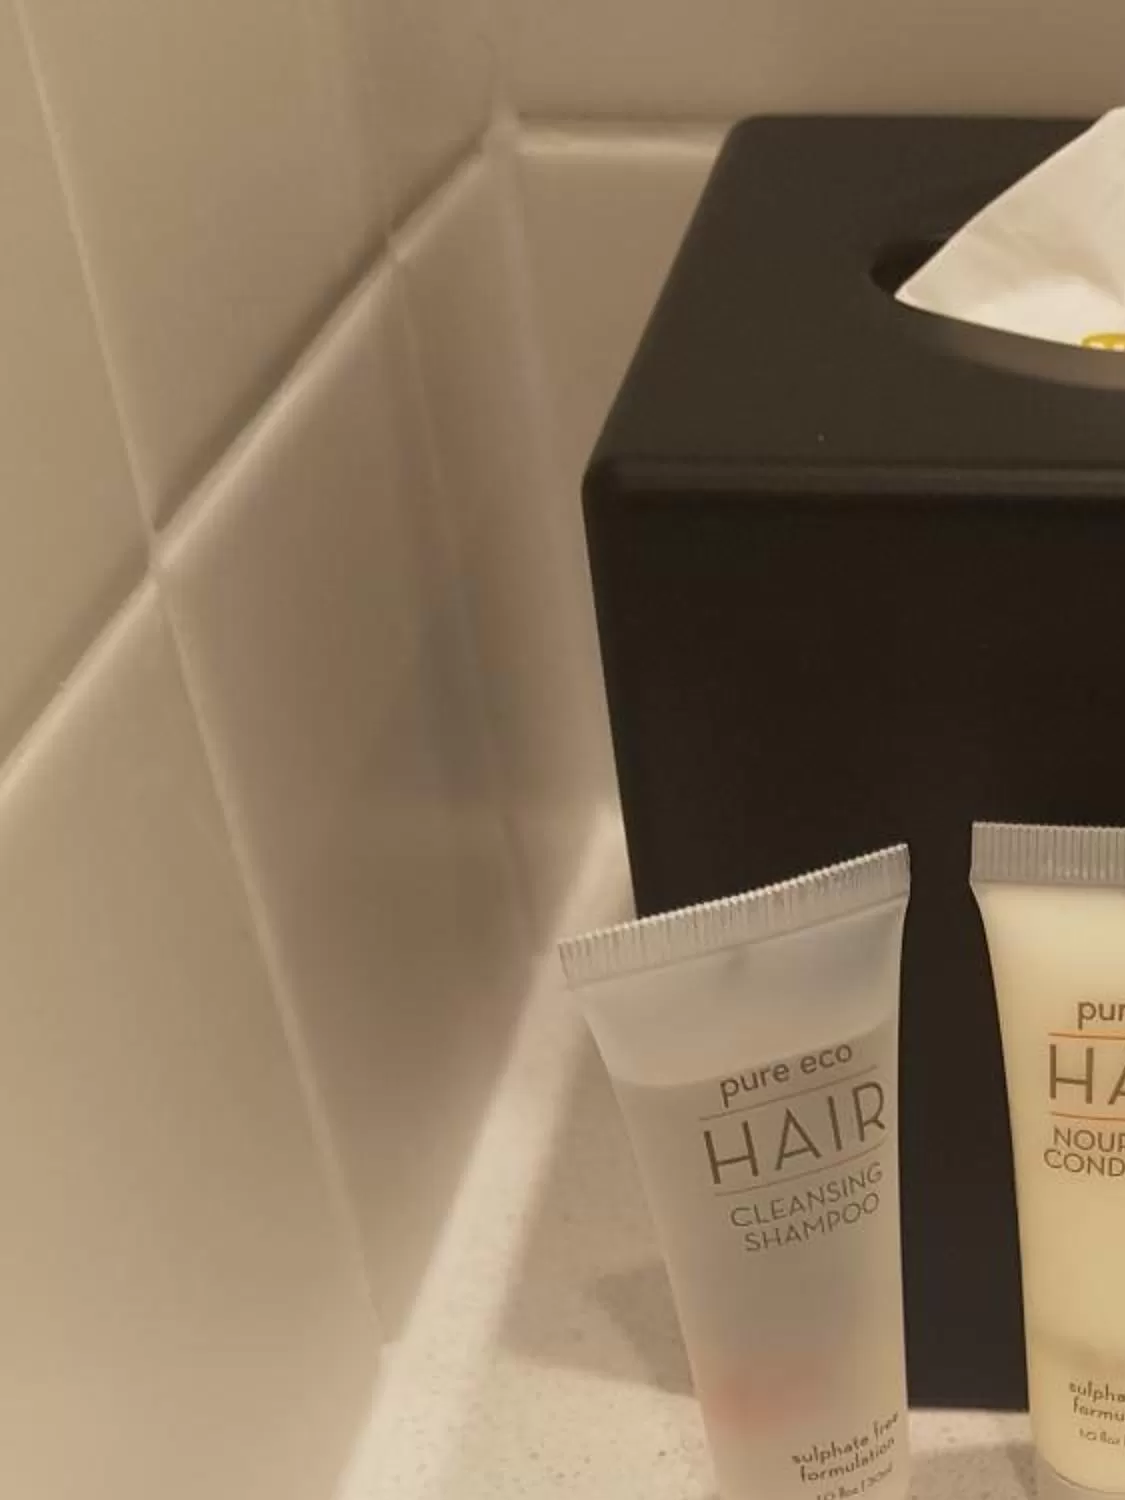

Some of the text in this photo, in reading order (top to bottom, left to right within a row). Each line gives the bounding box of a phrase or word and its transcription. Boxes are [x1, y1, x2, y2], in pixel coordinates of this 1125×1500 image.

[719, 1043, 854, 1109] pure eco
[703, 1081, 886, 1185] HAIR
[730, 1161, 883, 1227] CLEANSING
[744, 1192, 880, 1253] SHAMPOO
[791, 1435, 870, 1465] sulphate
[800, 1436, 895, 1483] formulation
